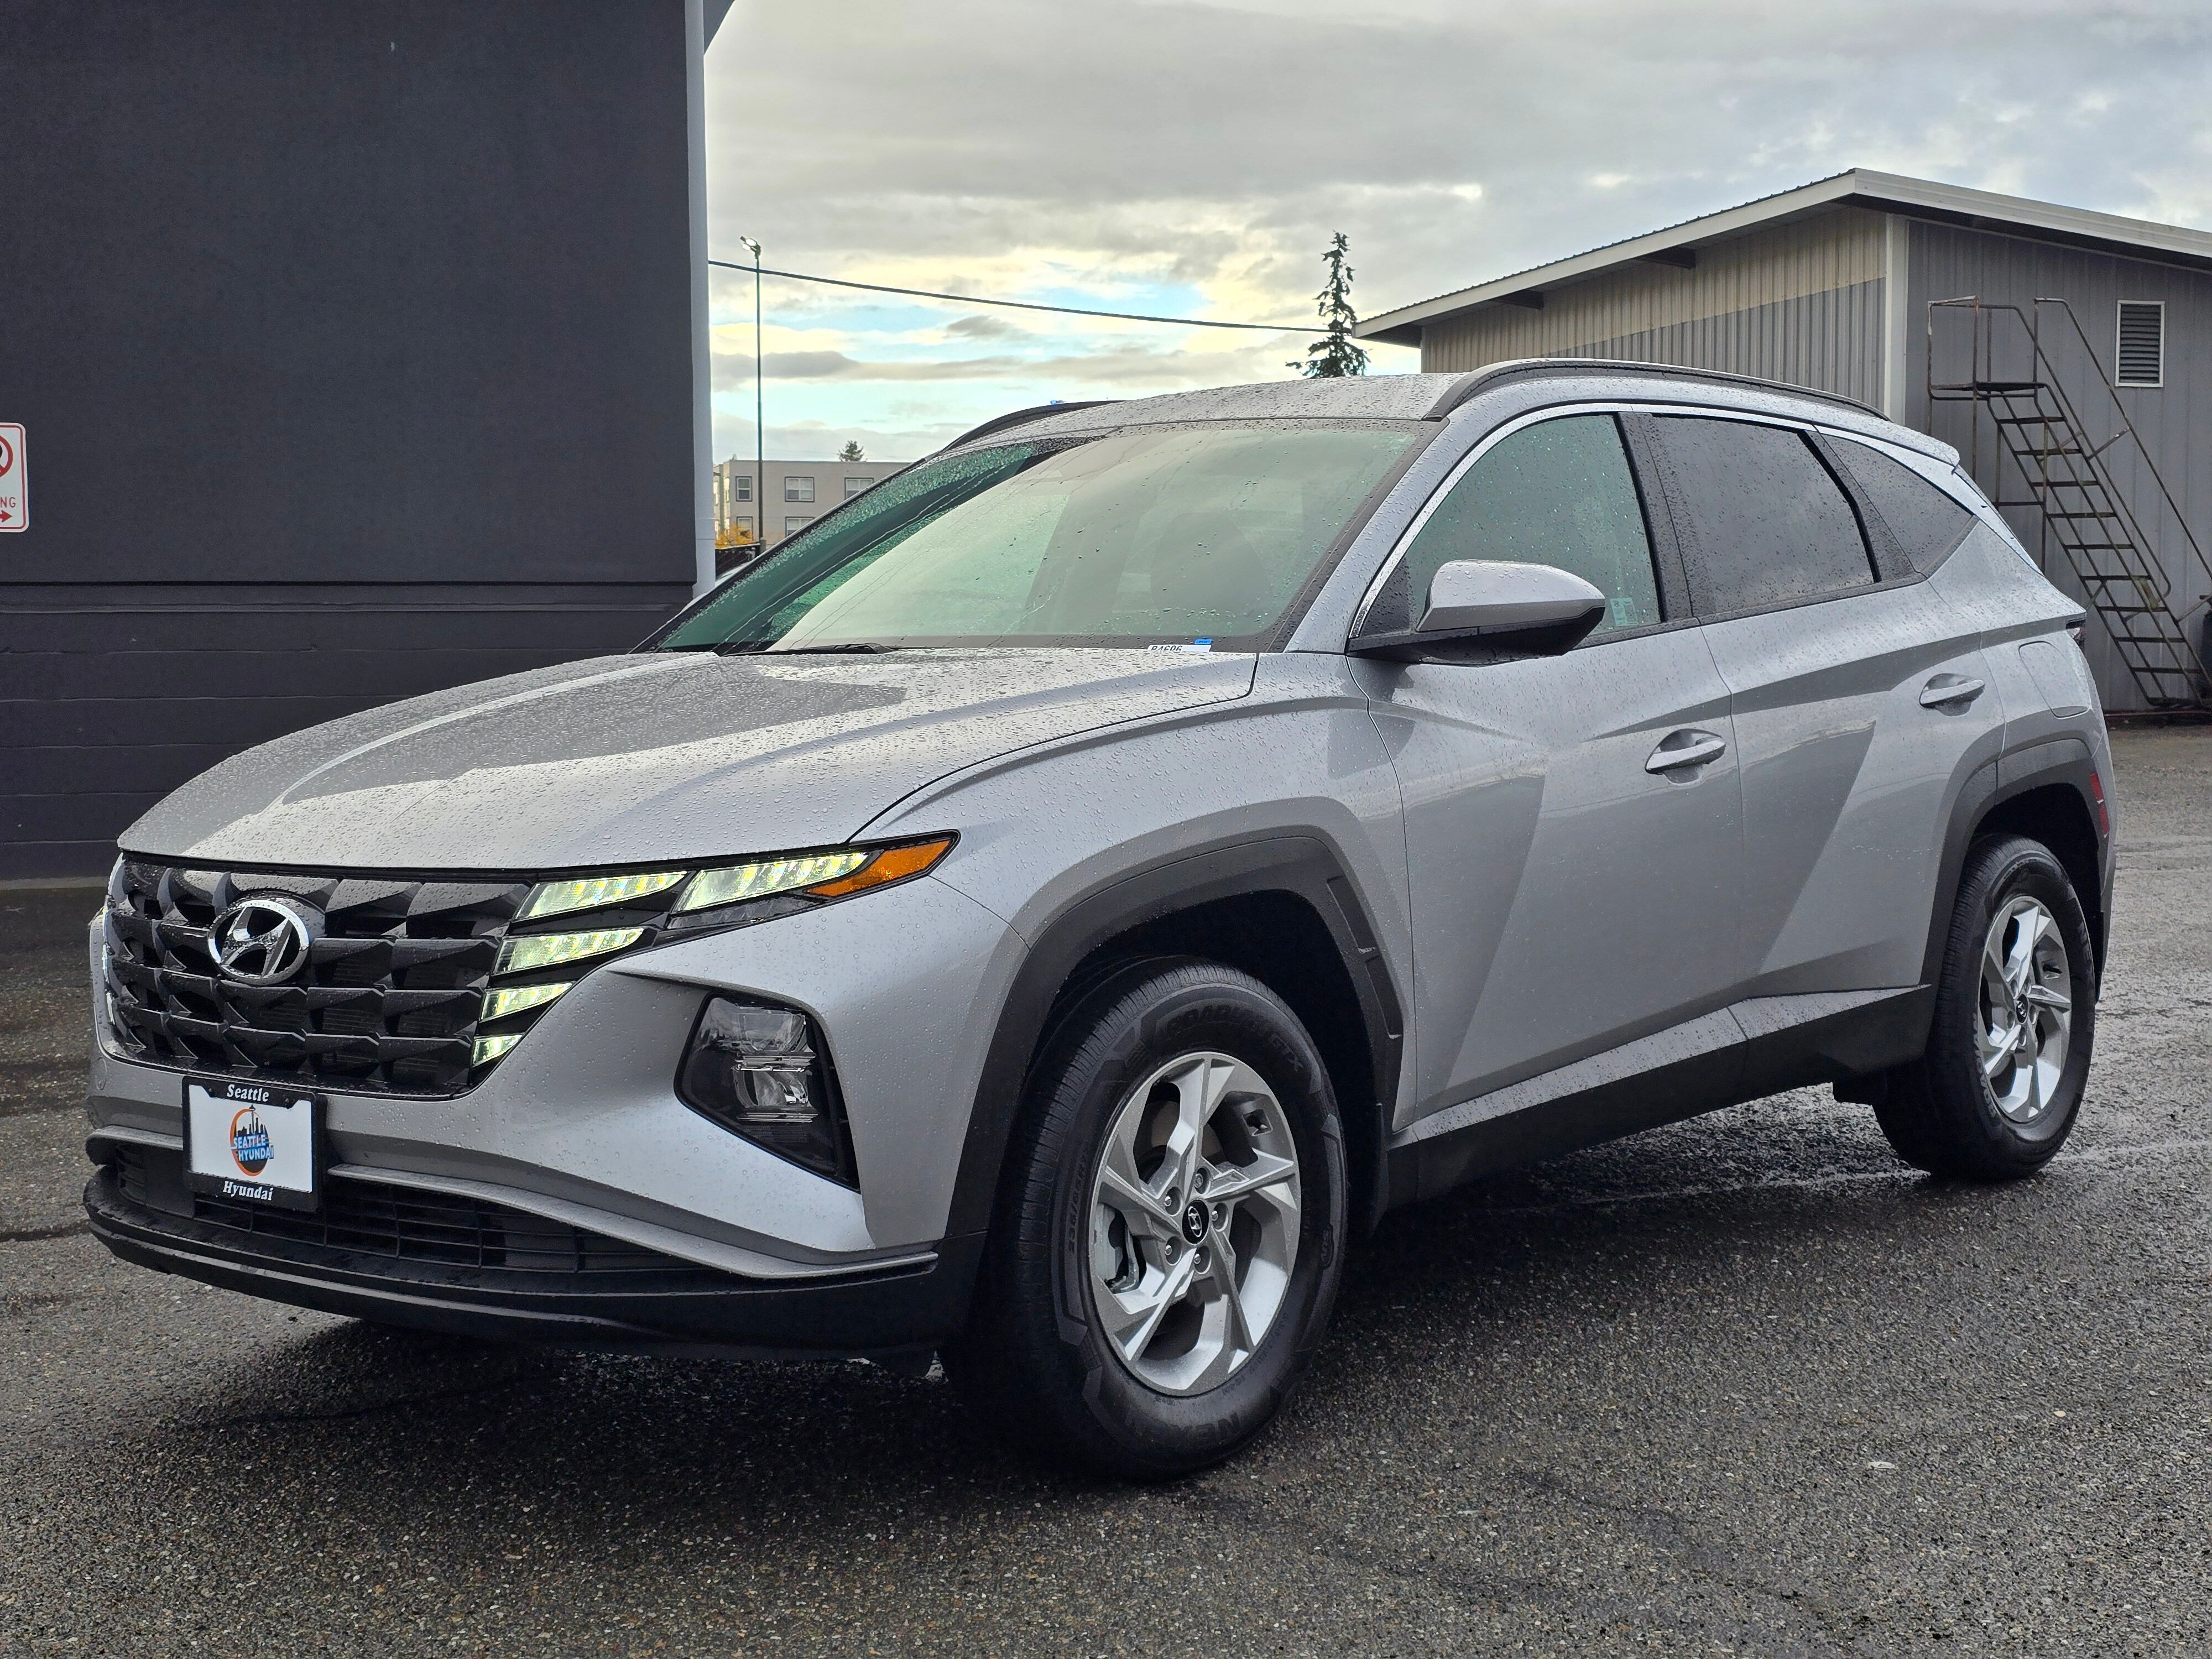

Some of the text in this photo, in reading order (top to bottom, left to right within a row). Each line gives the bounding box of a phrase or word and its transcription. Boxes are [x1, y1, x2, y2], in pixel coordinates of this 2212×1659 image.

[227, 1084, 269, 1102] Seattle
[233, 1134, 267, 1149] SEATTLE
[239, 1146, 274, 1161] HYUNDAI
[223, 1181, 274, 1201] Hyundai
